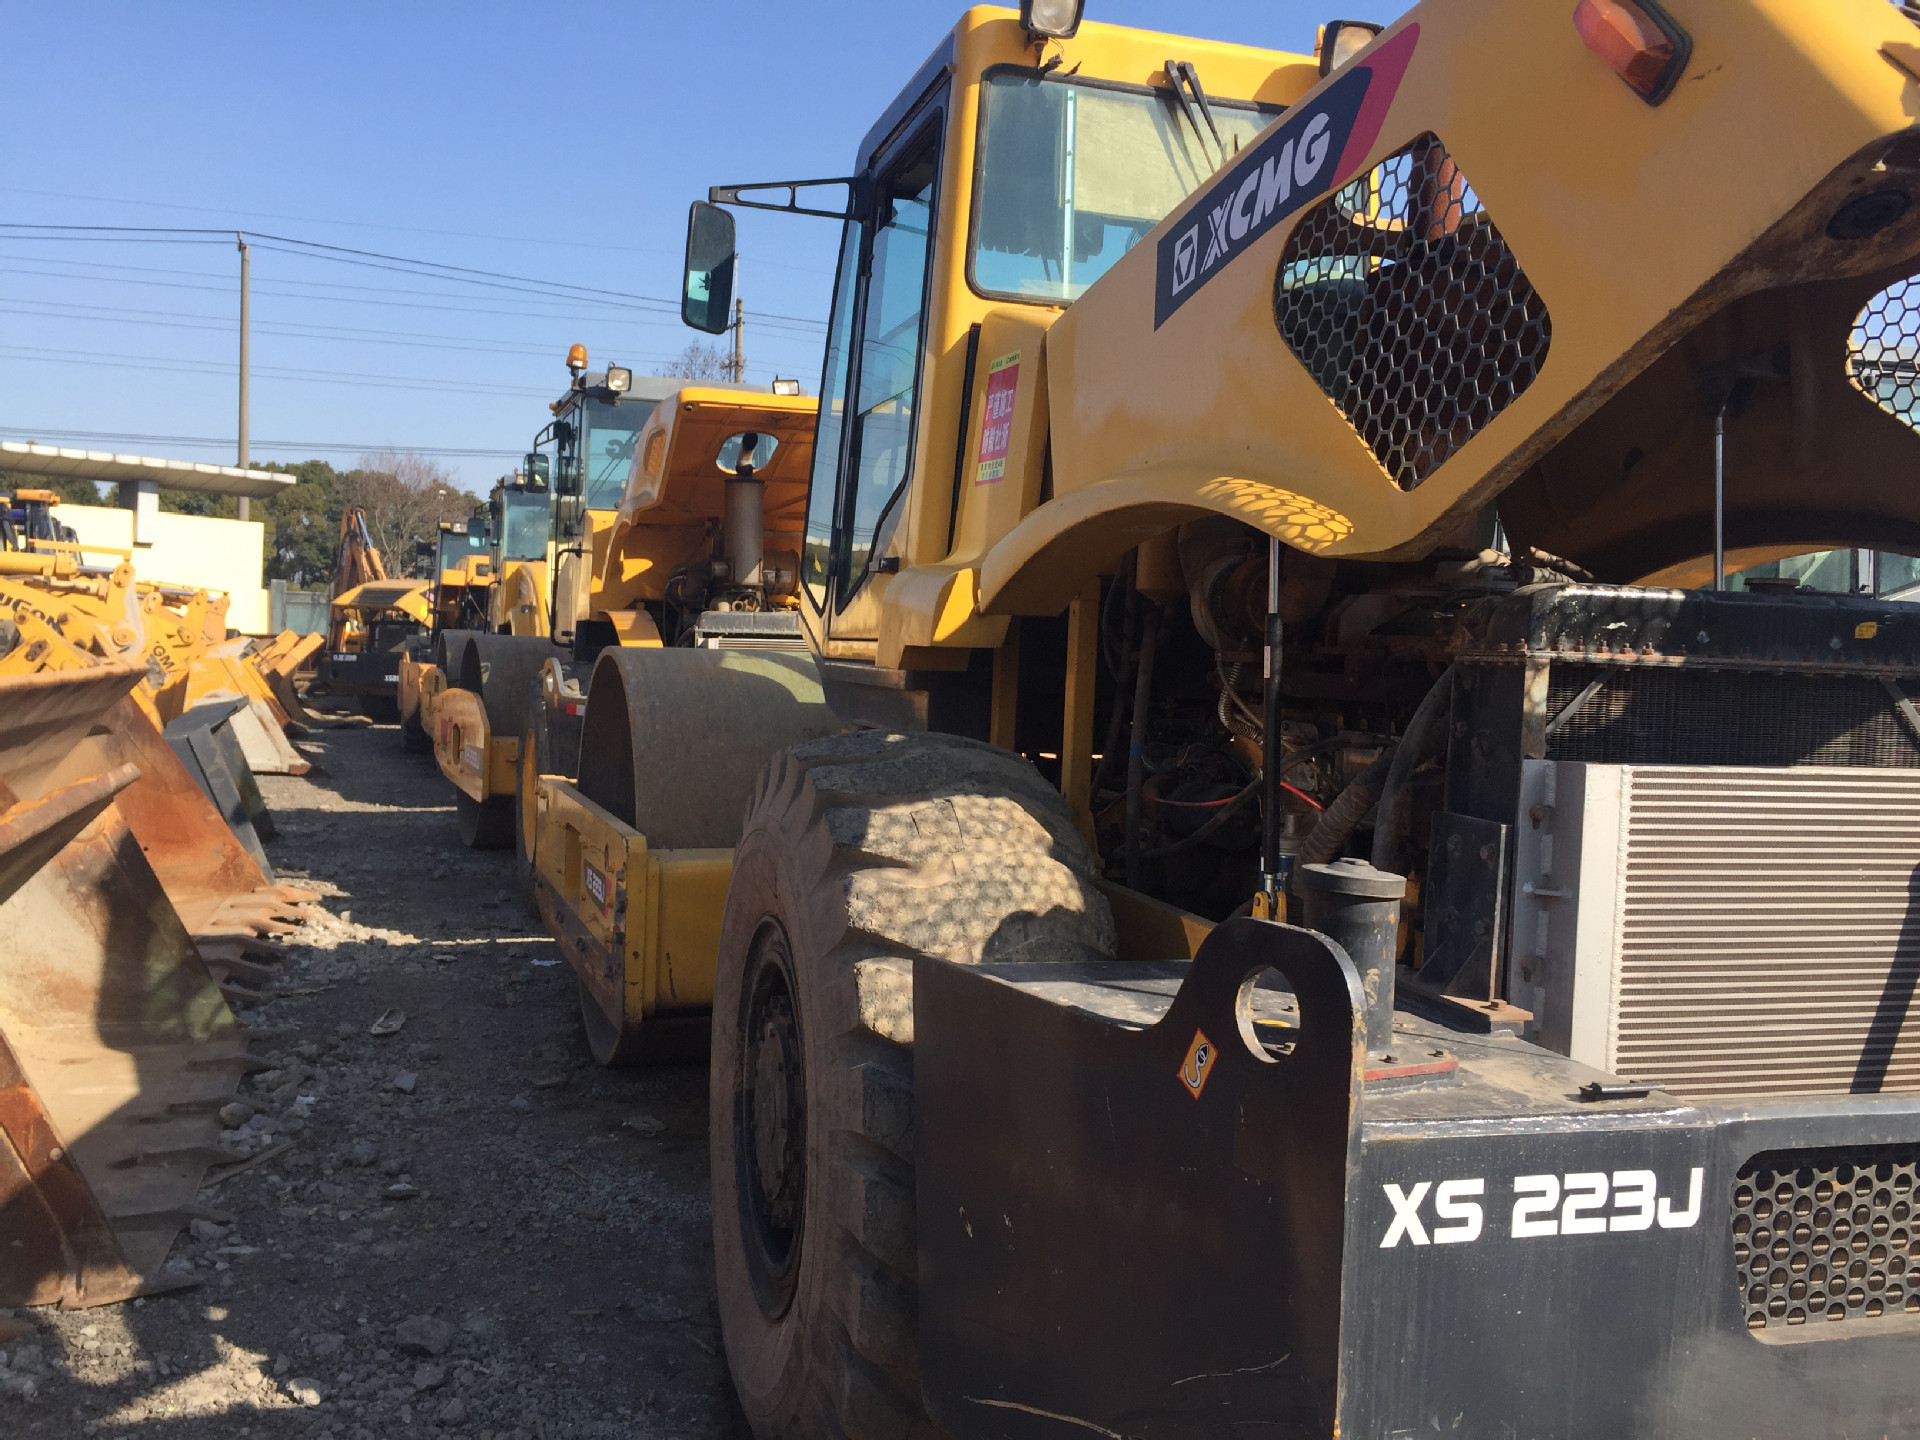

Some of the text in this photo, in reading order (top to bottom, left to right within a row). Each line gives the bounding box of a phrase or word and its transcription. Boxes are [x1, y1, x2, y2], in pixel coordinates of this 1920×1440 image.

[1200, 112, 1331, 275] XCMG
[1379, 1167, 1704, 1249] XS 223J
